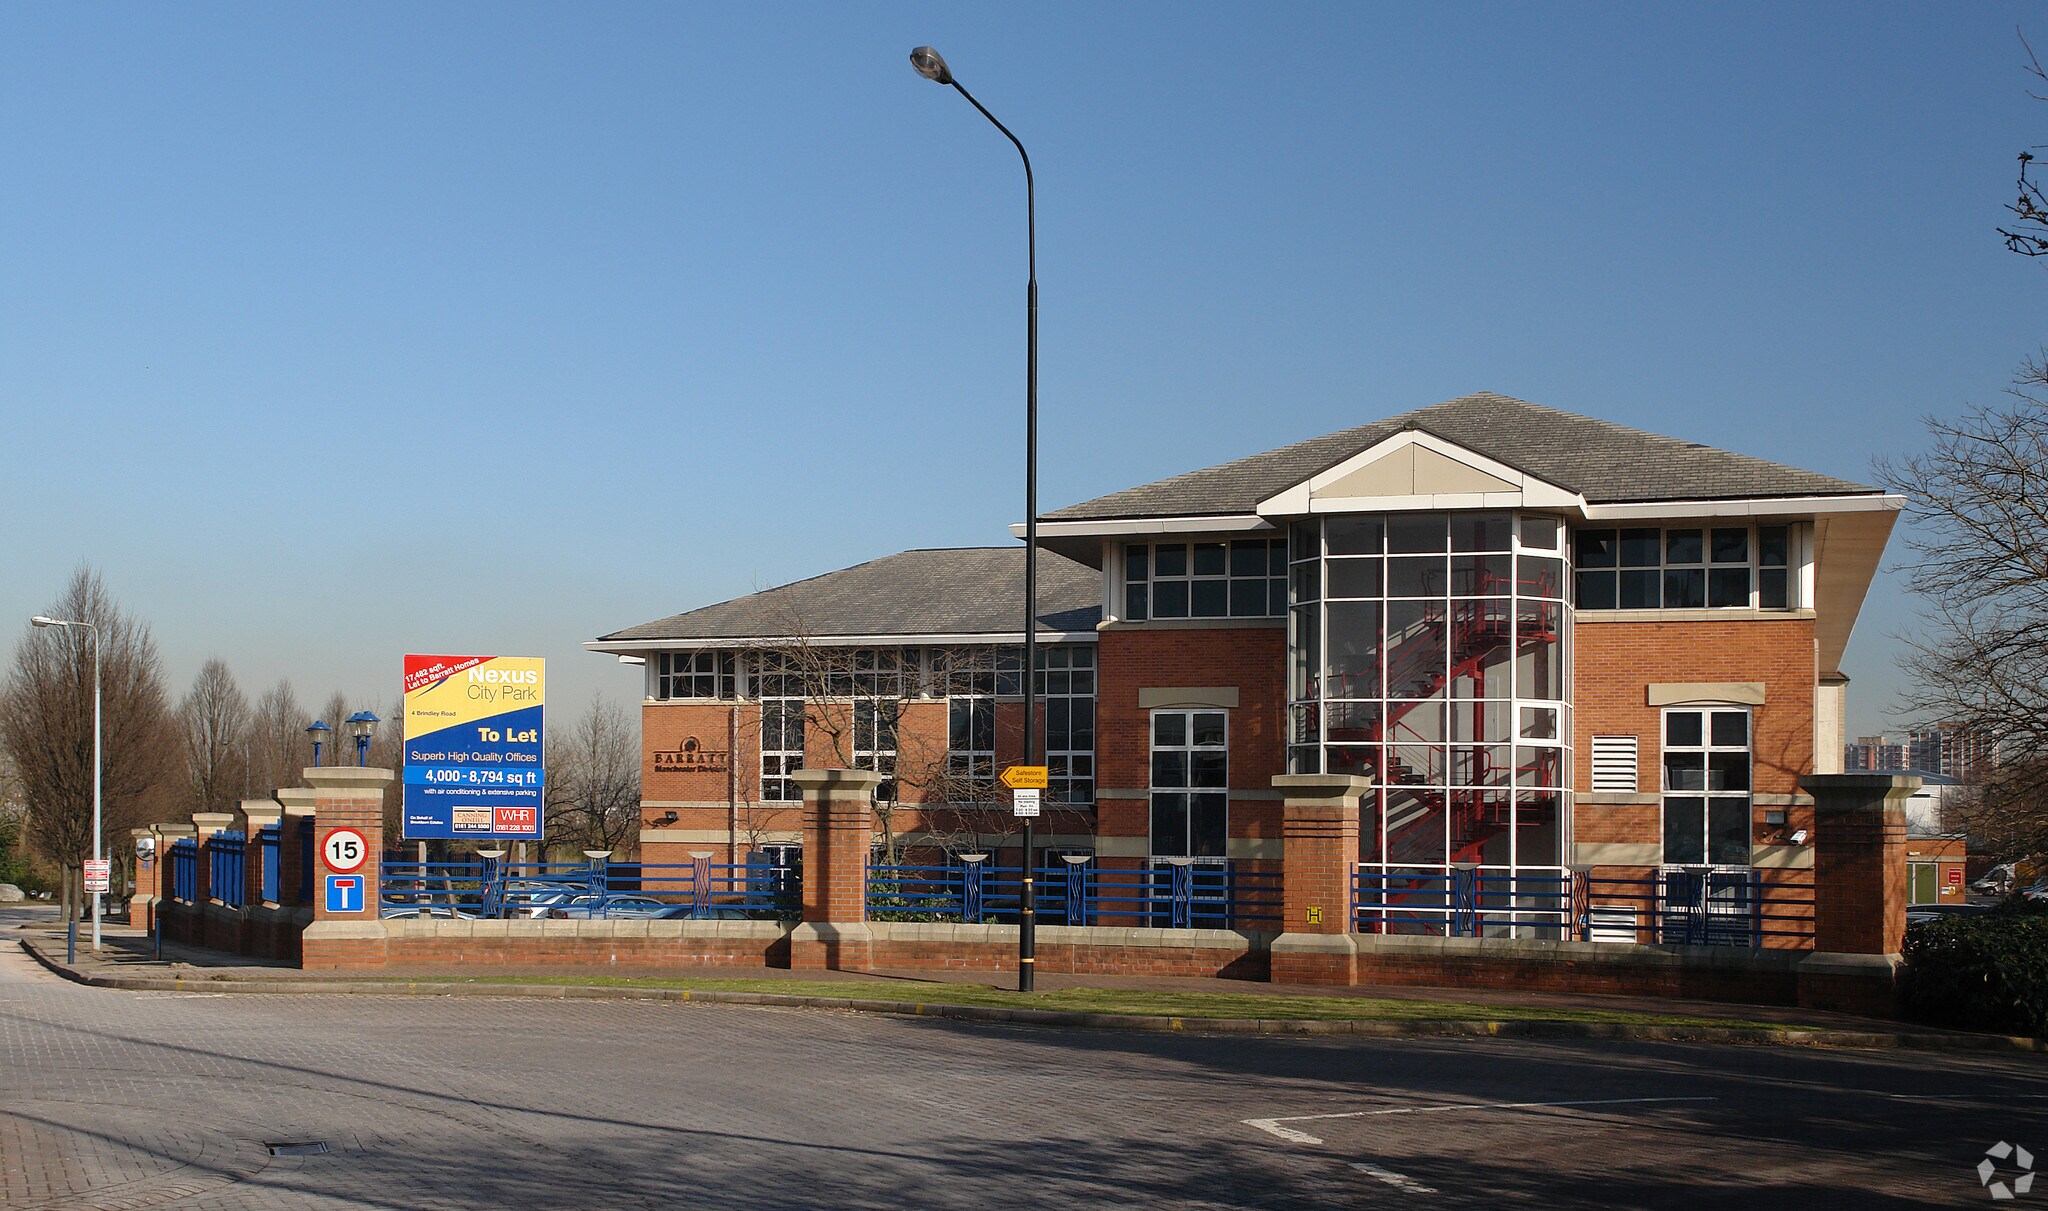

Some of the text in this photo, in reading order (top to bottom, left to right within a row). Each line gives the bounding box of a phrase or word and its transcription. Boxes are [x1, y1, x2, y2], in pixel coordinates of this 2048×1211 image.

[405, 668, 428, 683] 17,482
[407, 658, 480, 690] Let to Barratt Homes
[468, 665, 538, 685] Nexus
[467, 684, 537, 703] City Park
[477, 727, 538, 743] To Let
[411, 750, 537, 763] Superb High Quality Offices
[655, 754, 727, 763] BARRATT
[655, 765, 727, 773] Manchester Division
[425, 769, 460, 783] 4,000
[469, 771, 503, 784] 8,794
[506, 773, 523, 786] sq
[525, 772, 536, 784] ft
[500, 809, 530, 821] WHR
[332, 841, 358, 859] 15
